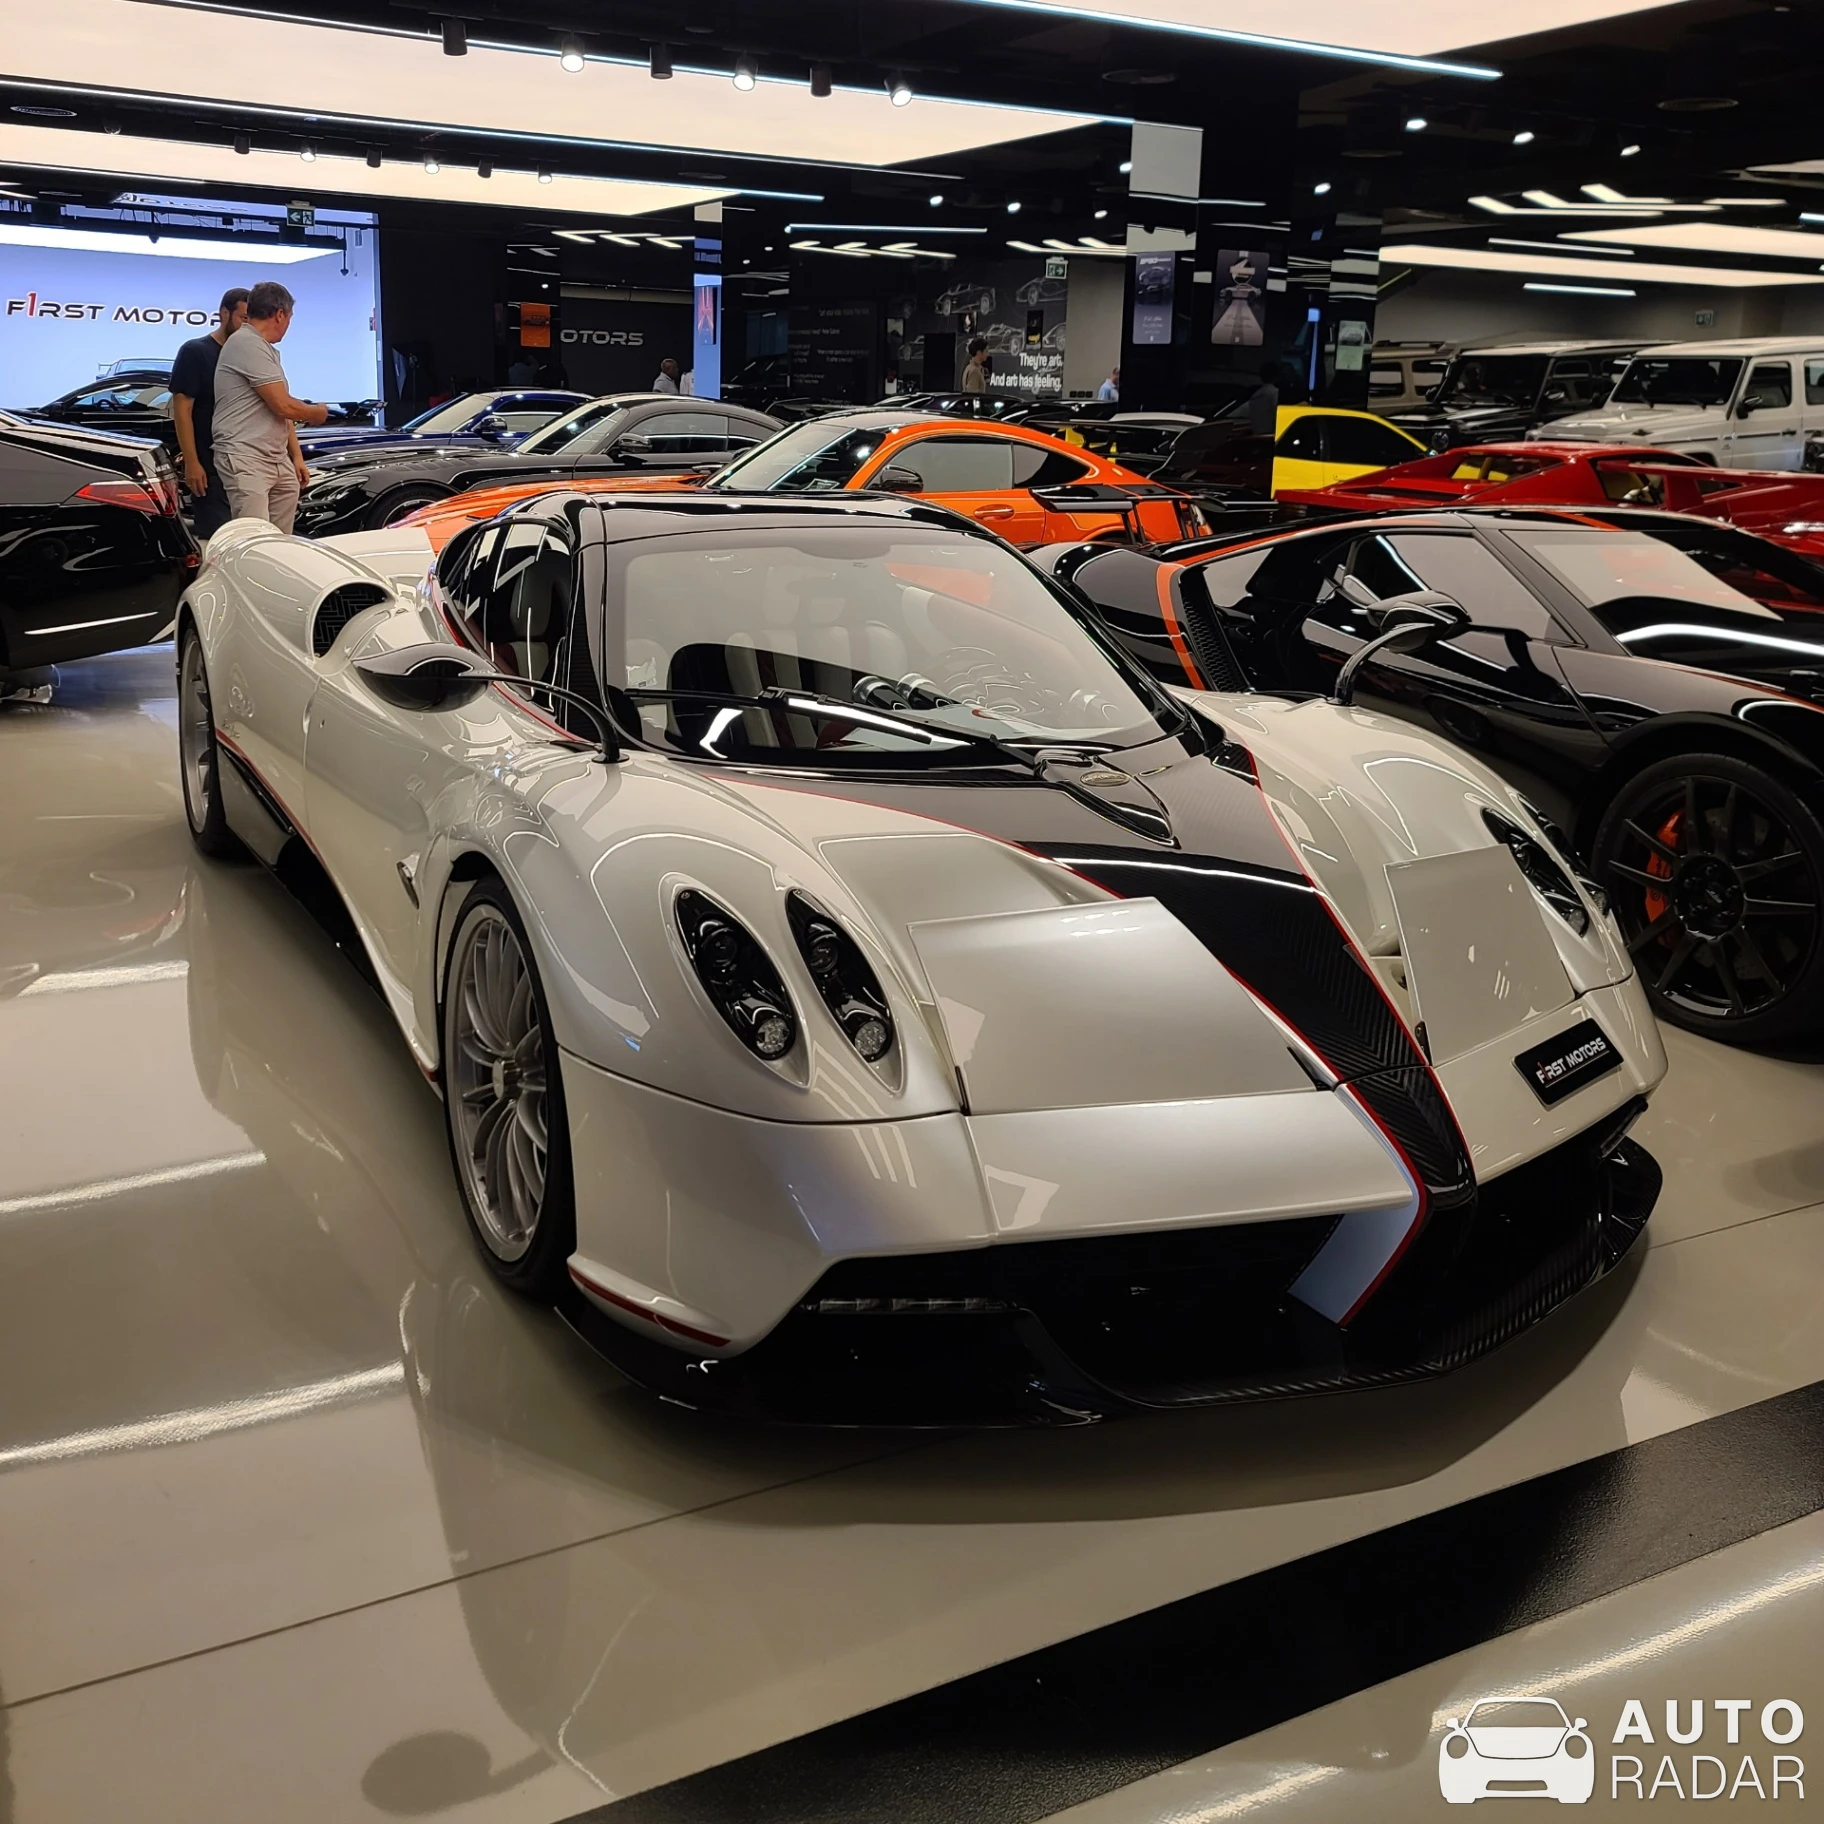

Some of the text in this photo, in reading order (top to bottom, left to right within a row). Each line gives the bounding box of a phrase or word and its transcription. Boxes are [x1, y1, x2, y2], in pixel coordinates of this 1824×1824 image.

[559, 328, 644, 346] OTORS
[989, 372, 1006, 386] And
[1006, 374, 1018, 386] art
[1019, 373, 1033, 387] has
[1565, 1037, 1606, 1067] MOTORS
